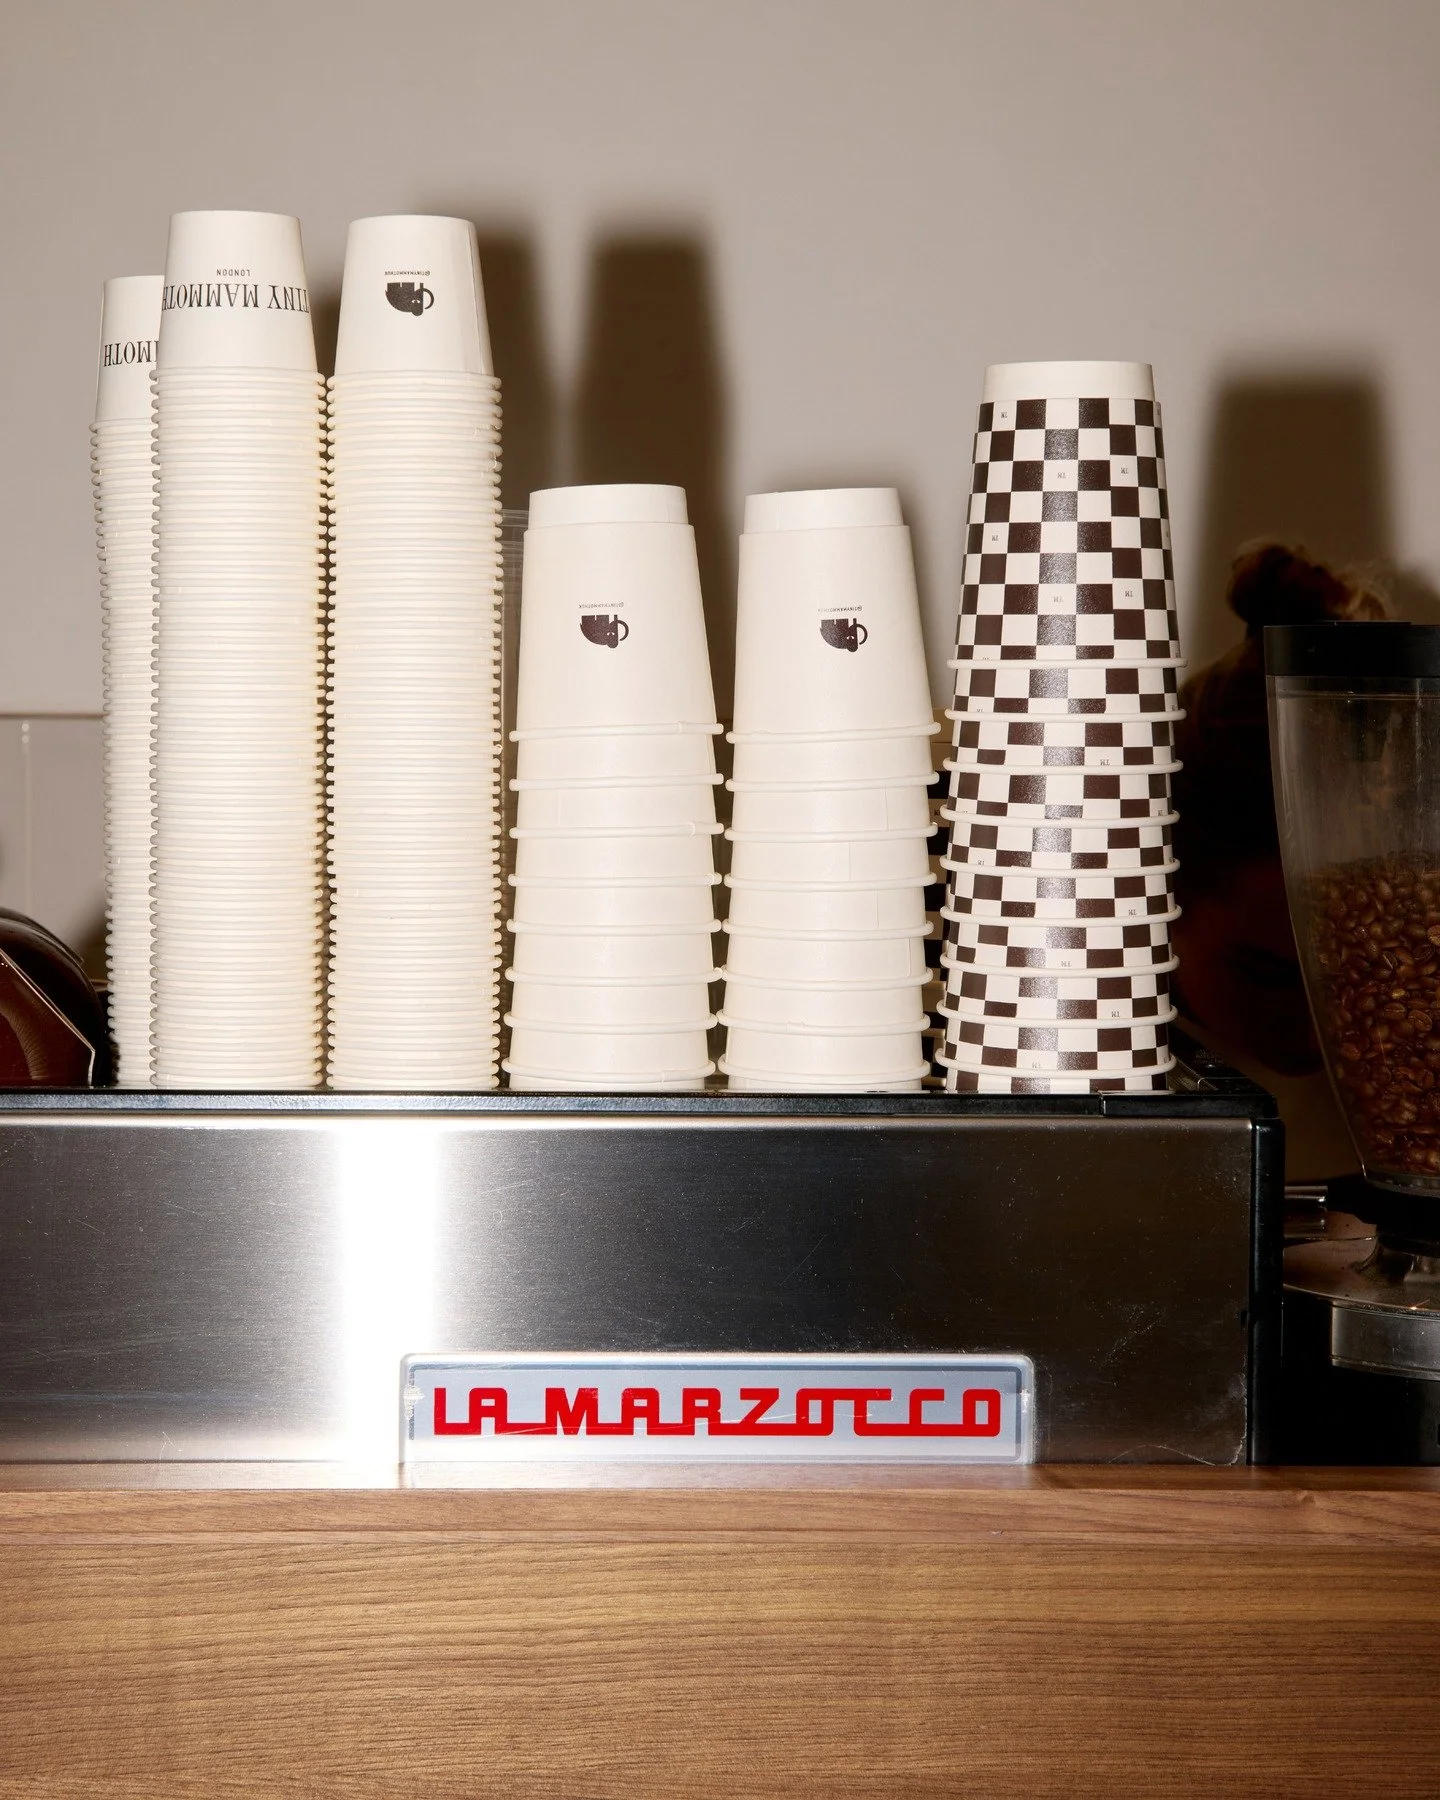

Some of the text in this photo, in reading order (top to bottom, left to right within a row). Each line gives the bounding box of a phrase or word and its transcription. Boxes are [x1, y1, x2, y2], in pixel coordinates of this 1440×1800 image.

[216, 268, 251, 276] LONDON
[162, 283, 310, 313] TINY MAMMOTH
[434, 1387, 507, 1436] LA
